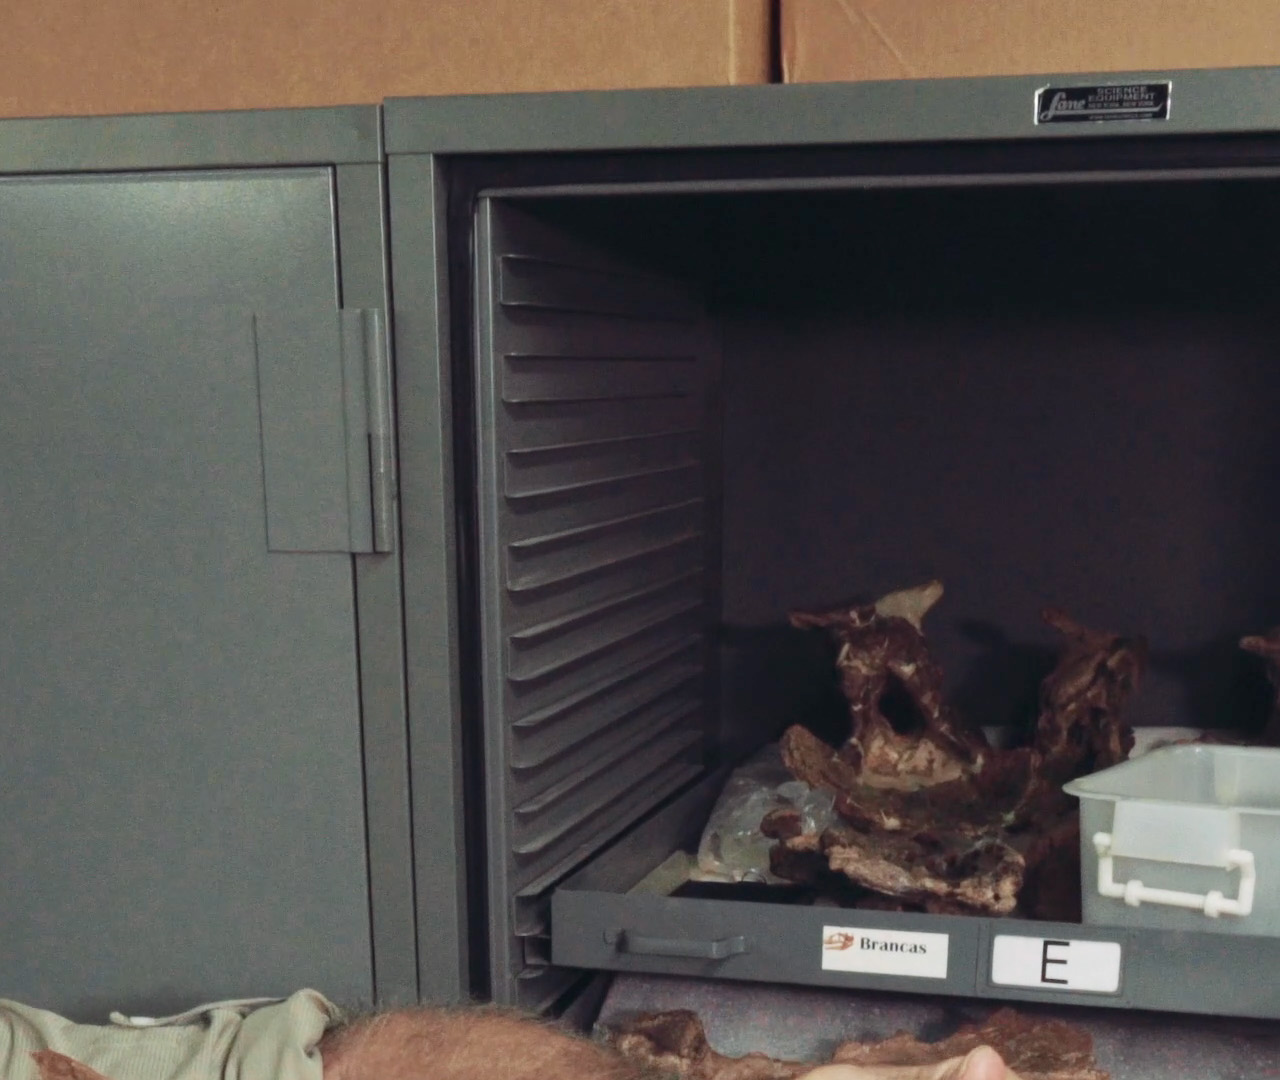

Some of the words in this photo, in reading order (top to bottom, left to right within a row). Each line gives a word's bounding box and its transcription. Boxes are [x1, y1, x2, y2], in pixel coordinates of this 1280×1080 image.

[1088, 93, 1155, 102] EQUIPMENT
[1097, 86, 1147, 96] SCIENCE
[860, 937, 927, 955] Brancas
[1040, 939, 1070, 984] E
